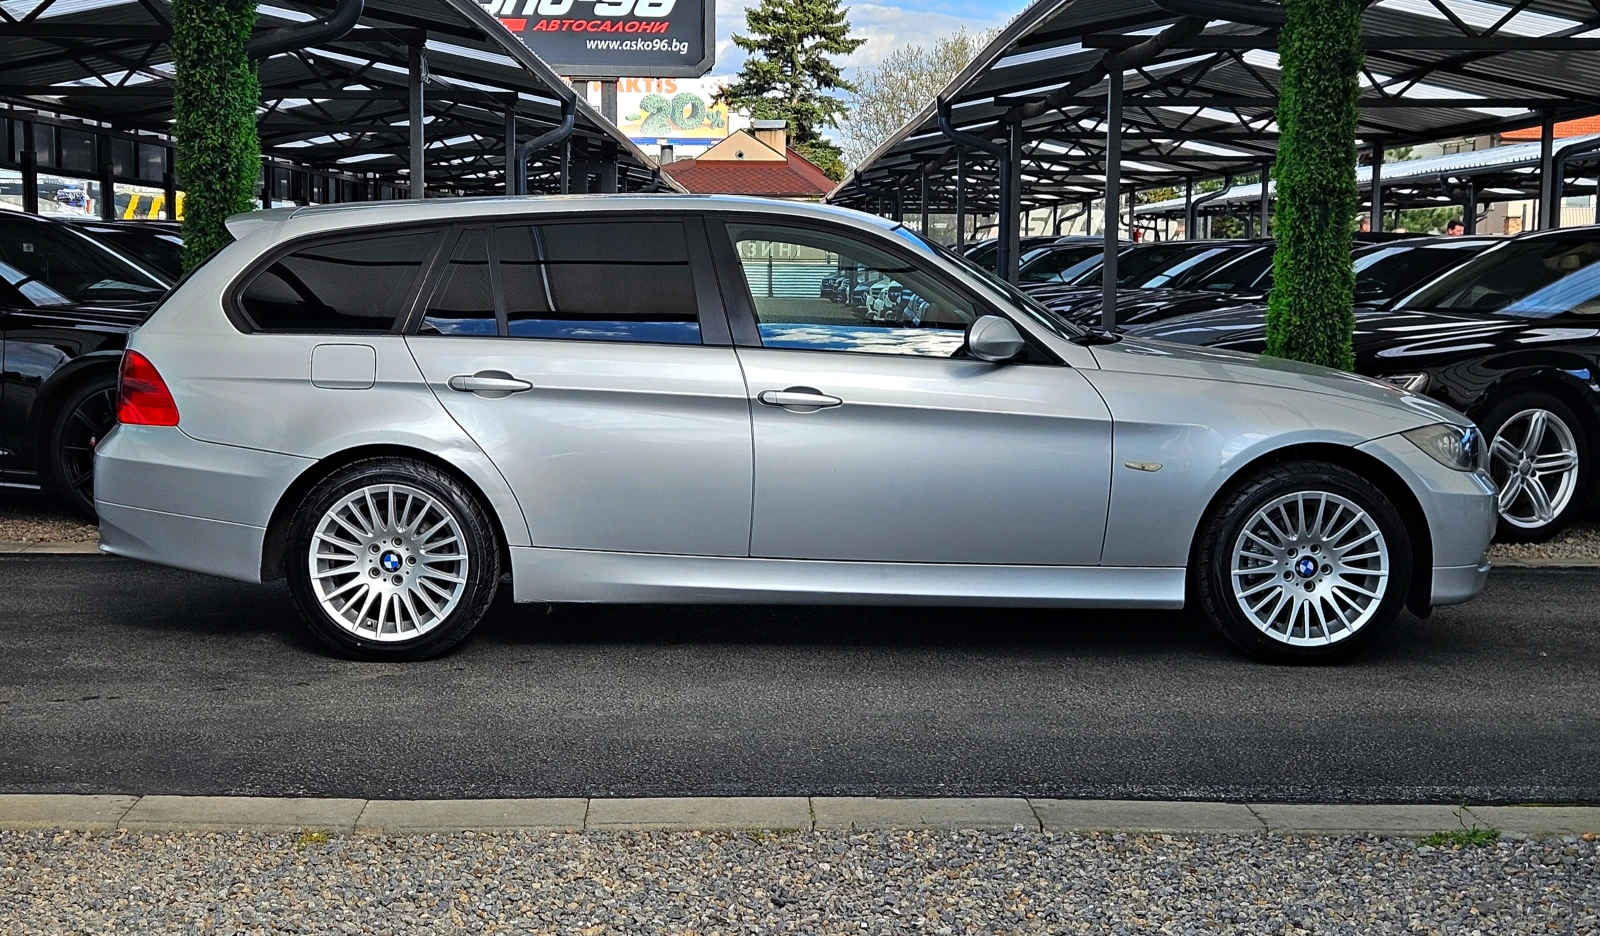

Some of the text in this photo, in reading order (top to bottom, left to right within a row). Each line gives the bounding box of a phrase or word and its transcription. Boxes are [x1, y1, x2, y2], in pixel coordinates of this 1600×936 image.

[533, 19, 670, 34] АВТОСАЛОНИ
[586, 38, 689, 54] www.asko96.bg
[625, 92, 726, 136] -20%
